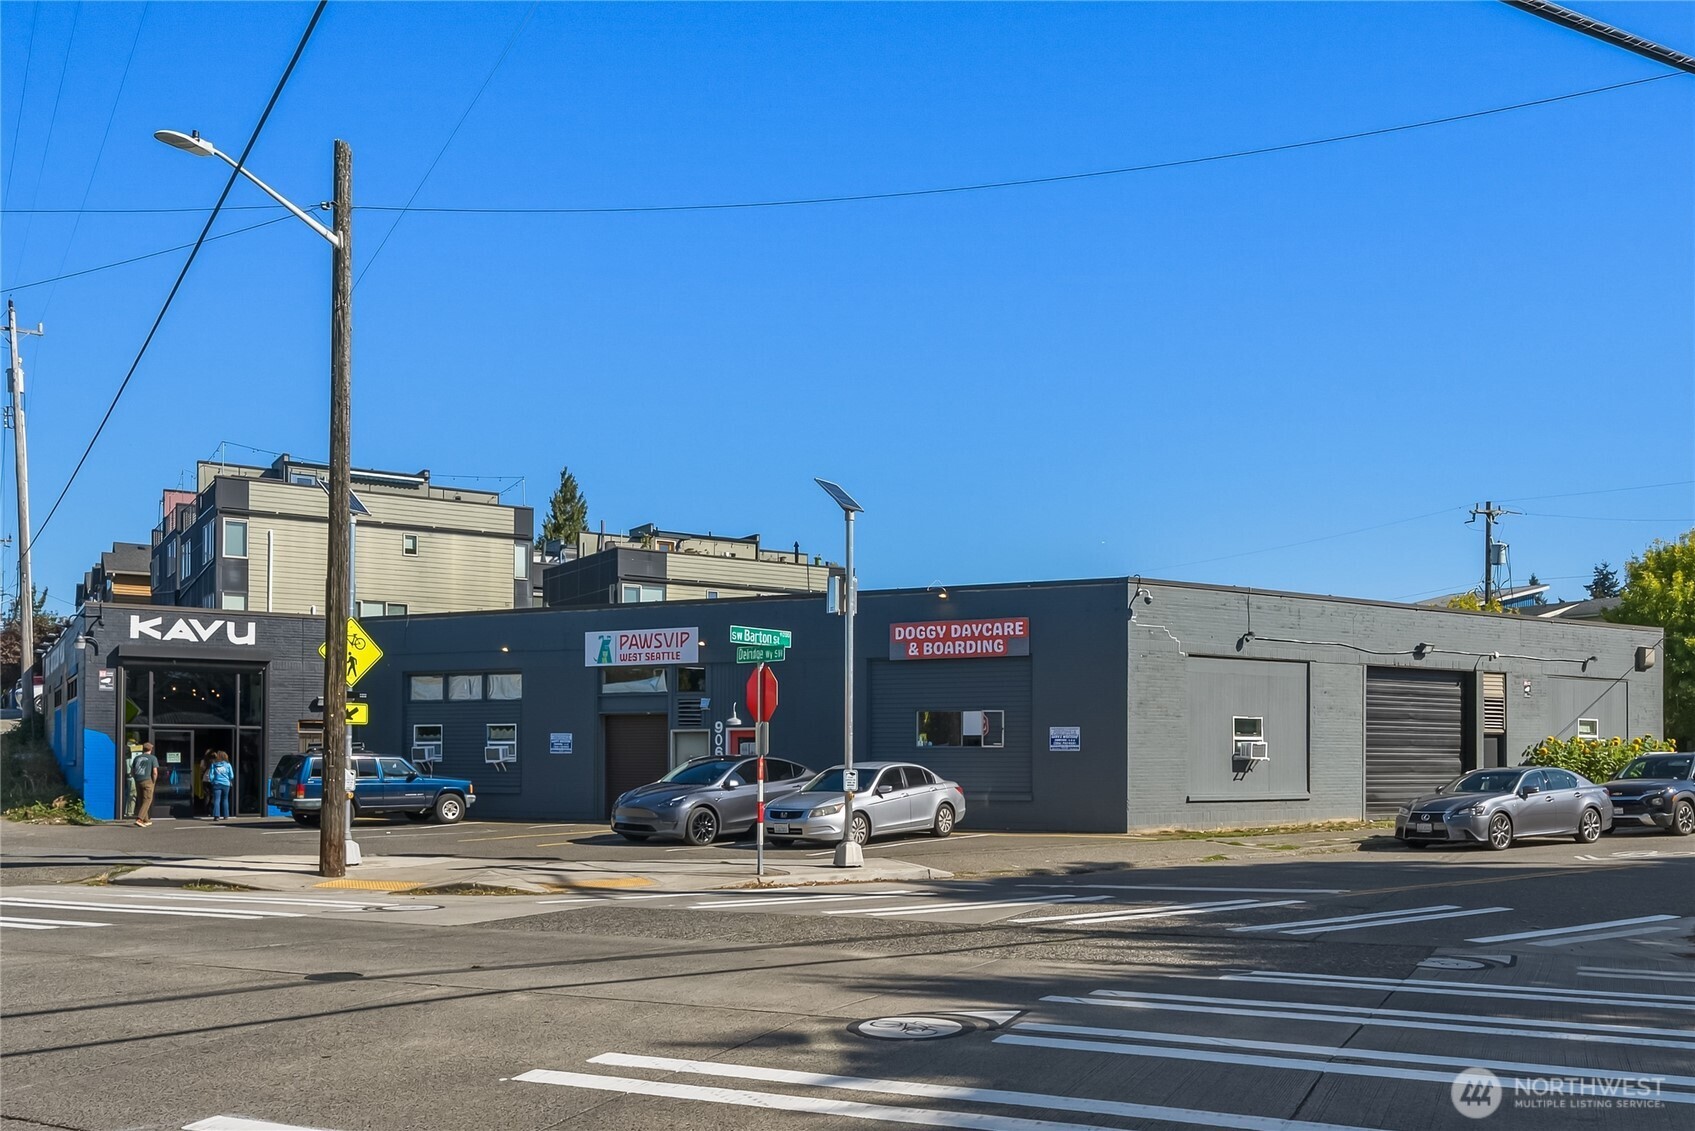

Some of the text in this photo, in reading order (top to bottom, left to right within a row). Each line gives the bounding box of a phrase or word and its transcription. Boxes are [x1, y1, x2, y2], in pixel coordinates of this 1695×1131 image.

[130, 615, 256, 645] KAVU
[732, 631, 742, 640] SW
[744, 629, 772, 644] Barton
[895, 622, 1024, 640] DOGGY DAYCARE
[619, 632, 690, 650] PAWSVIP
[908, 639, 1004, 656] & BOARDING
[619, 651, 681, 662] WEST SEATTLE
